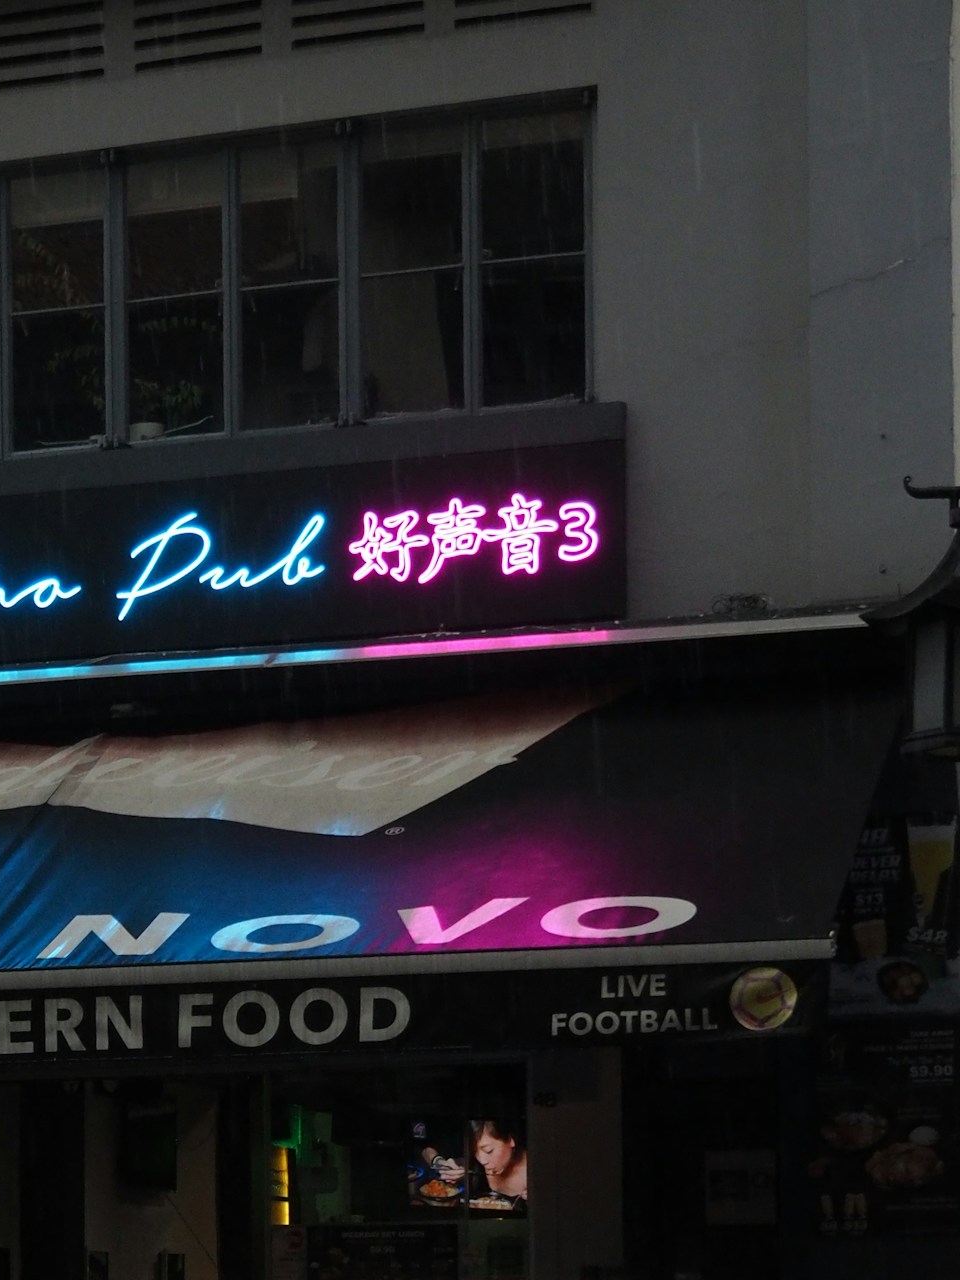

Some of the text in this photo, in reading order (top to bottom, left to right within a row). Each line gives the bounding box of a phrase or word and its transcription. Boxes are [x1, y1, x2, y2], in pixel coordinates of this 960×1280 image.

[348, 493, 600, 585] 好声音3
[115, 511, 325, 622] Pub
[36, 896, 698, 959] NOVO
[906, 926, 948, 945] $48
[600, 974, 667, 999] LIVE
[177, 986, 411, 1049] FOOD
[550, 1006, 718, 1037] FOOTBALL
[909, 1064, 954, 1078] $9.90
